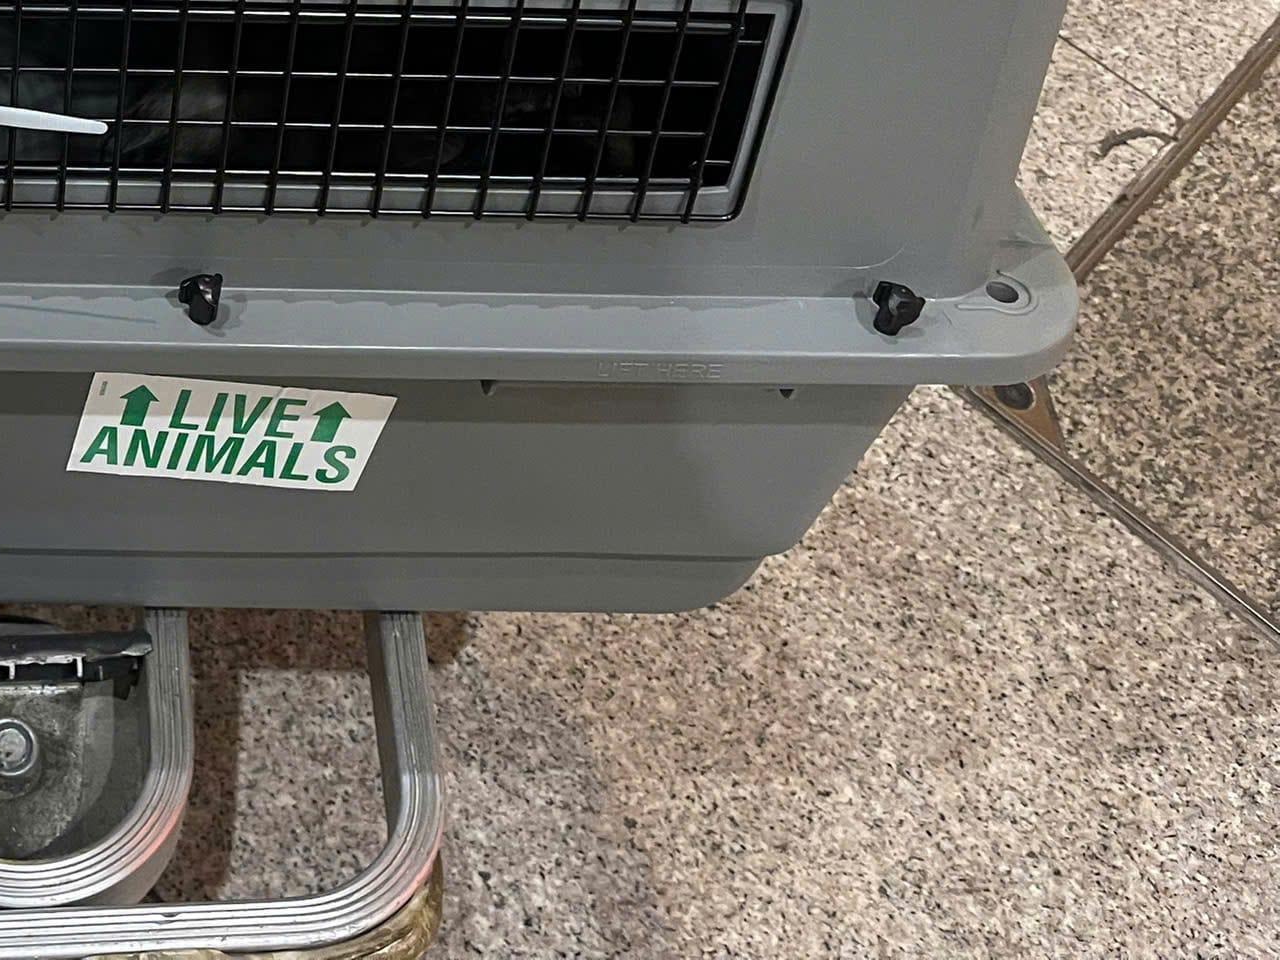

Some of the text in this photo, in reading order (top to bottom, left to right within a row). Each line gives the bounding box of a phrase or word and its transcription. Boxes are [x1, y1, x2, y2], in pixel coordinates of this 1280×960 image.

[597, 362, 723, 379] LIFT HERE
[169, 389, 308, 439] LIVE
[80, 426, 357, 484] ANIMALS
